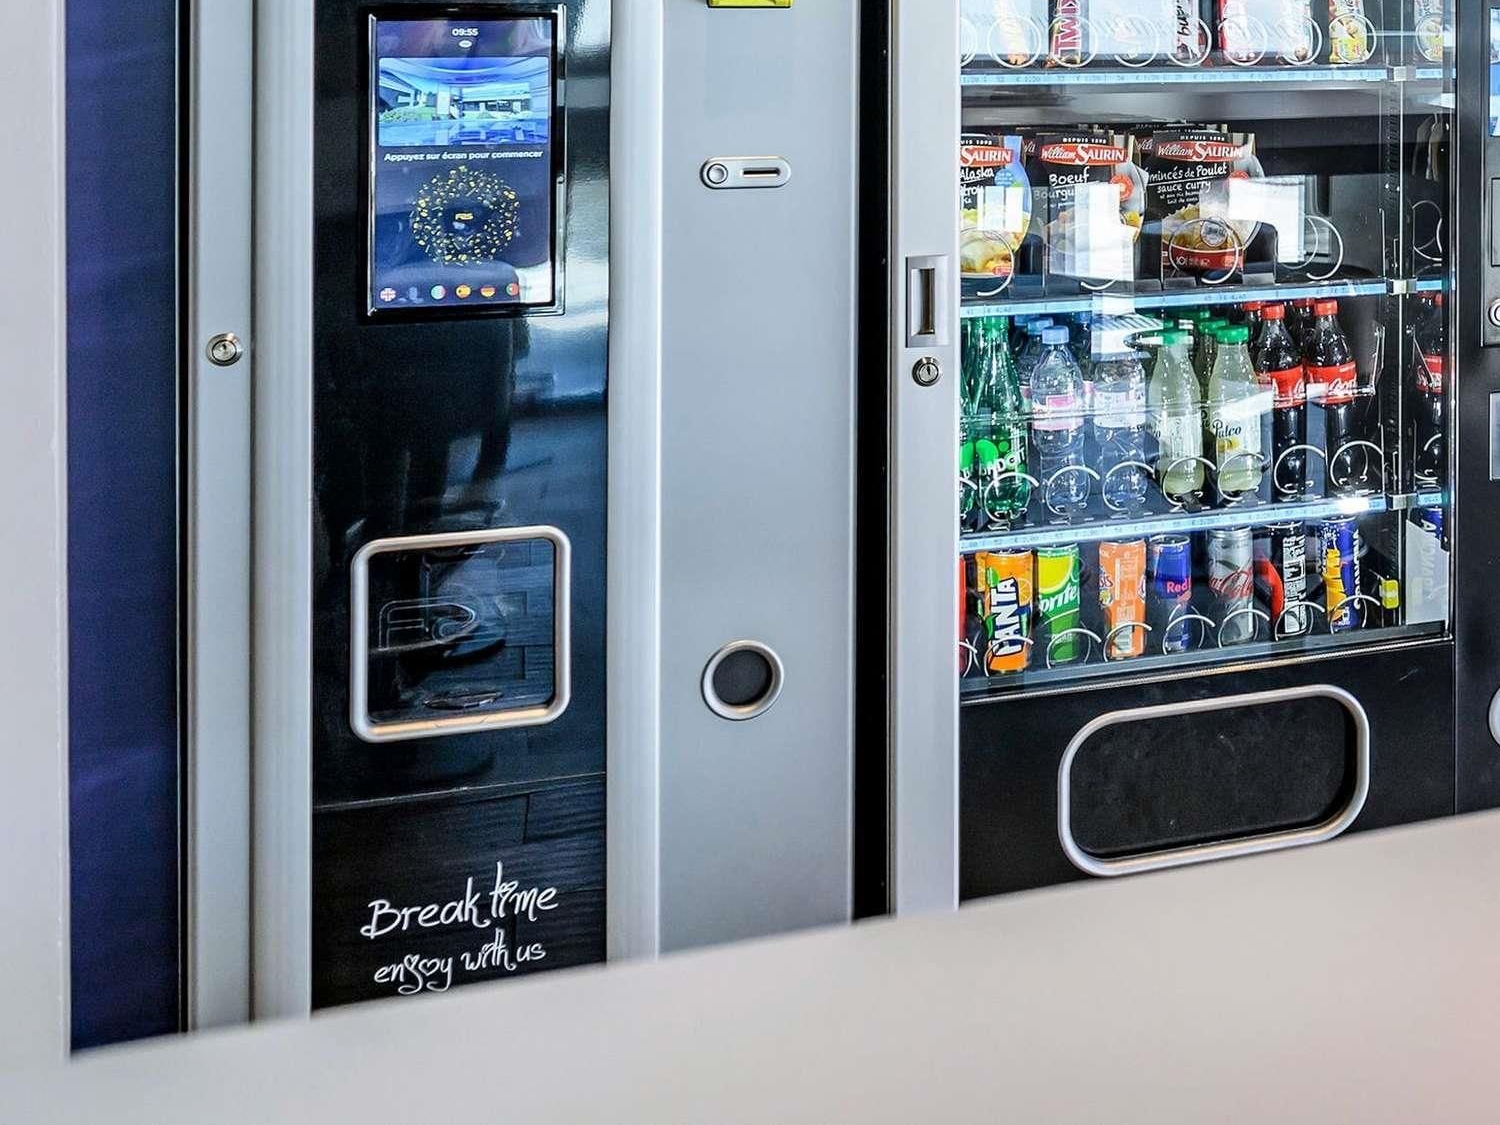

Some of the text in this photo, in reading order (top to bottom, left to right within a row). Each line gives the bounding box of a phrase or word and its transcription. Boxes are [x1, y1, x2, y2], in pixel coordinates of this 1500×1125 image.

[451, 28, 479, 37] 09:55
[384, 153, 425, 162] Appuyez
[469, 153, 489, 162] pour
[491, 150, 544, 159] commencer
[960, 145, 1012, 167] SAURIN
[1041, 146, 1076, 160] William
[1074, 143, 1125, 165] SAURIN
[1157, 142, 1193, 156] William
[1048, 166, 1090, 187] Boeuf
[1148, 165, 1183, 183] mincés
[1196, 161, 1228, 177] Poulet
[1156, 180, 1212, 195] sauce curry
[1212, 419, 1242, 439] Pulco
[1166, 578, 1188, 594] Red
[991, 578, 1022, 656] FANTA
[360, 861, 559, 939] Break time
[461, 927, 517, 971] with
[516, 942, 547, 963] us
